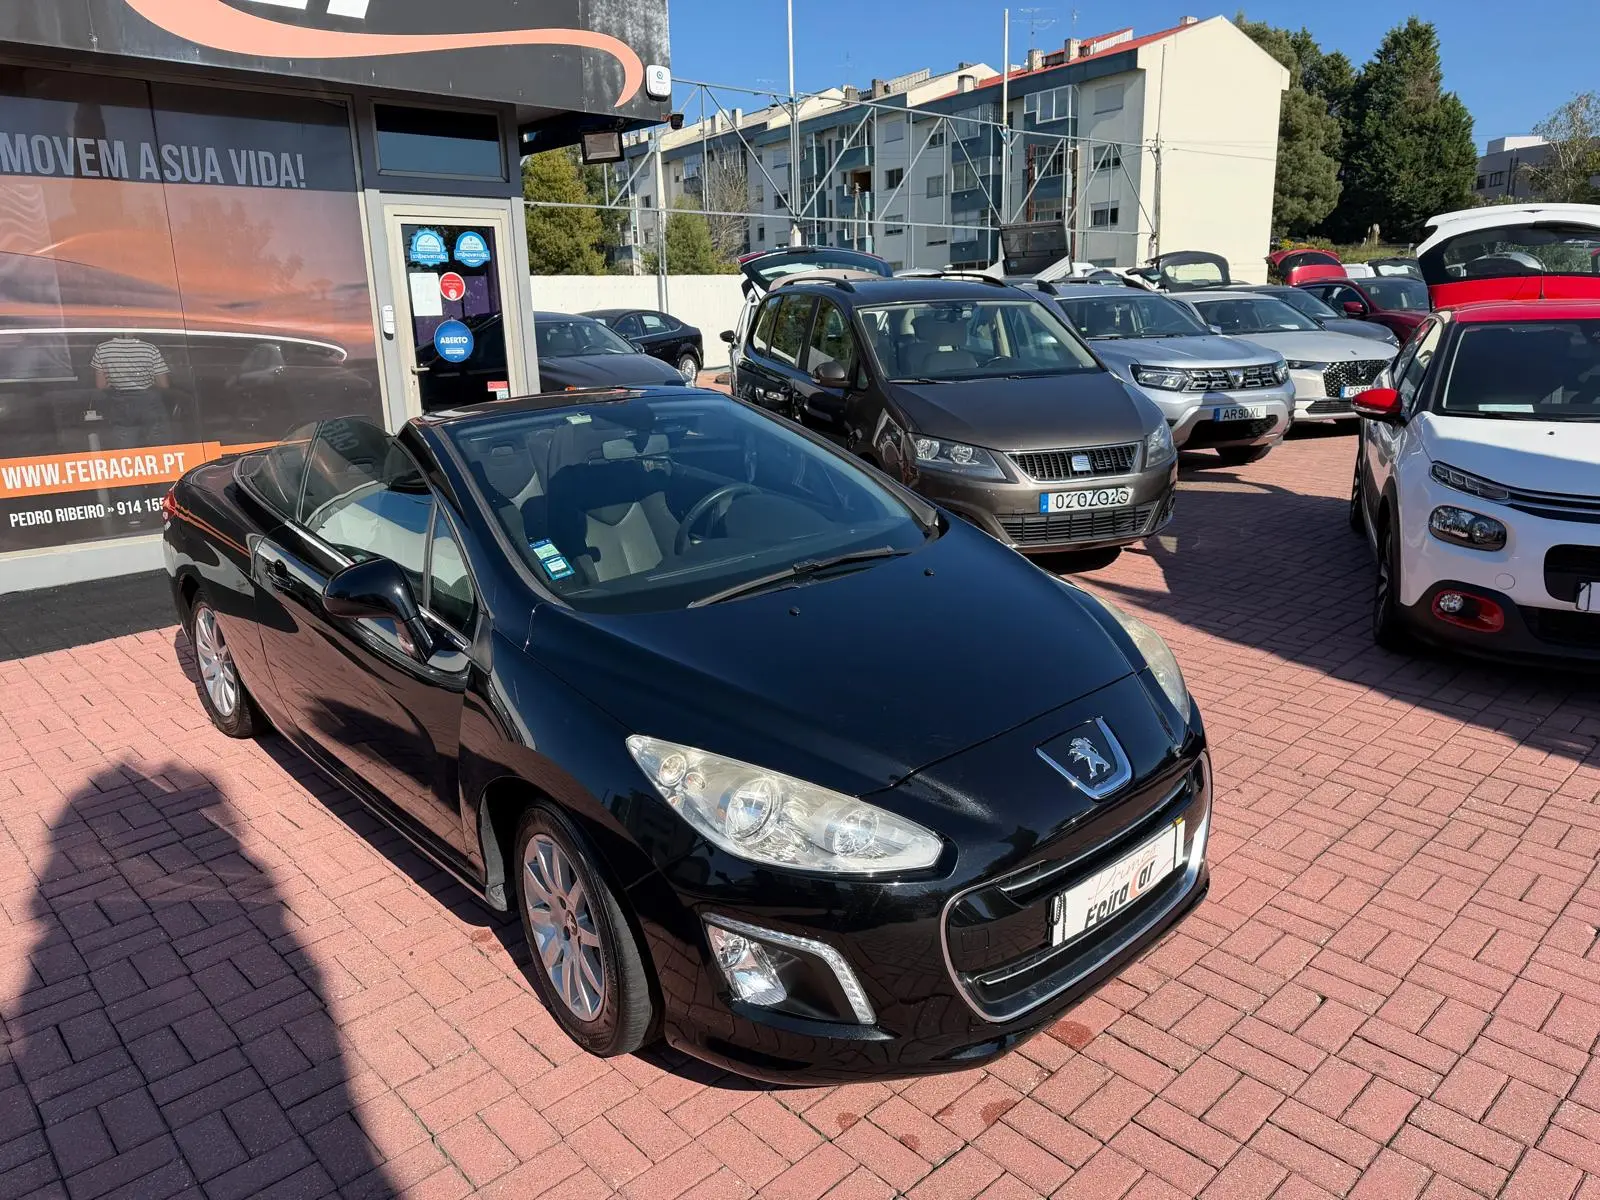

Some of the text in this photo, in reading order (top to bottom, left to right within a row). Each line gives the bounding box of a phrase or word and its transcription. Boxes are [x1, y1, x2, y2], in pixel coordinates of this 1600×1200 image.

[0, 132, 129, 179] MOVEM
[228, 148, 307, 189] VIDA!
[440, 336, 468, 344] ABERTO
[2, 452, 185, 489] WWW.FEIRACAR.PT
[9, 509, 54, 528] PEDRO
[55, 503, 105, 524] RIBEIRO
[116, 500, 142, 516] 914
